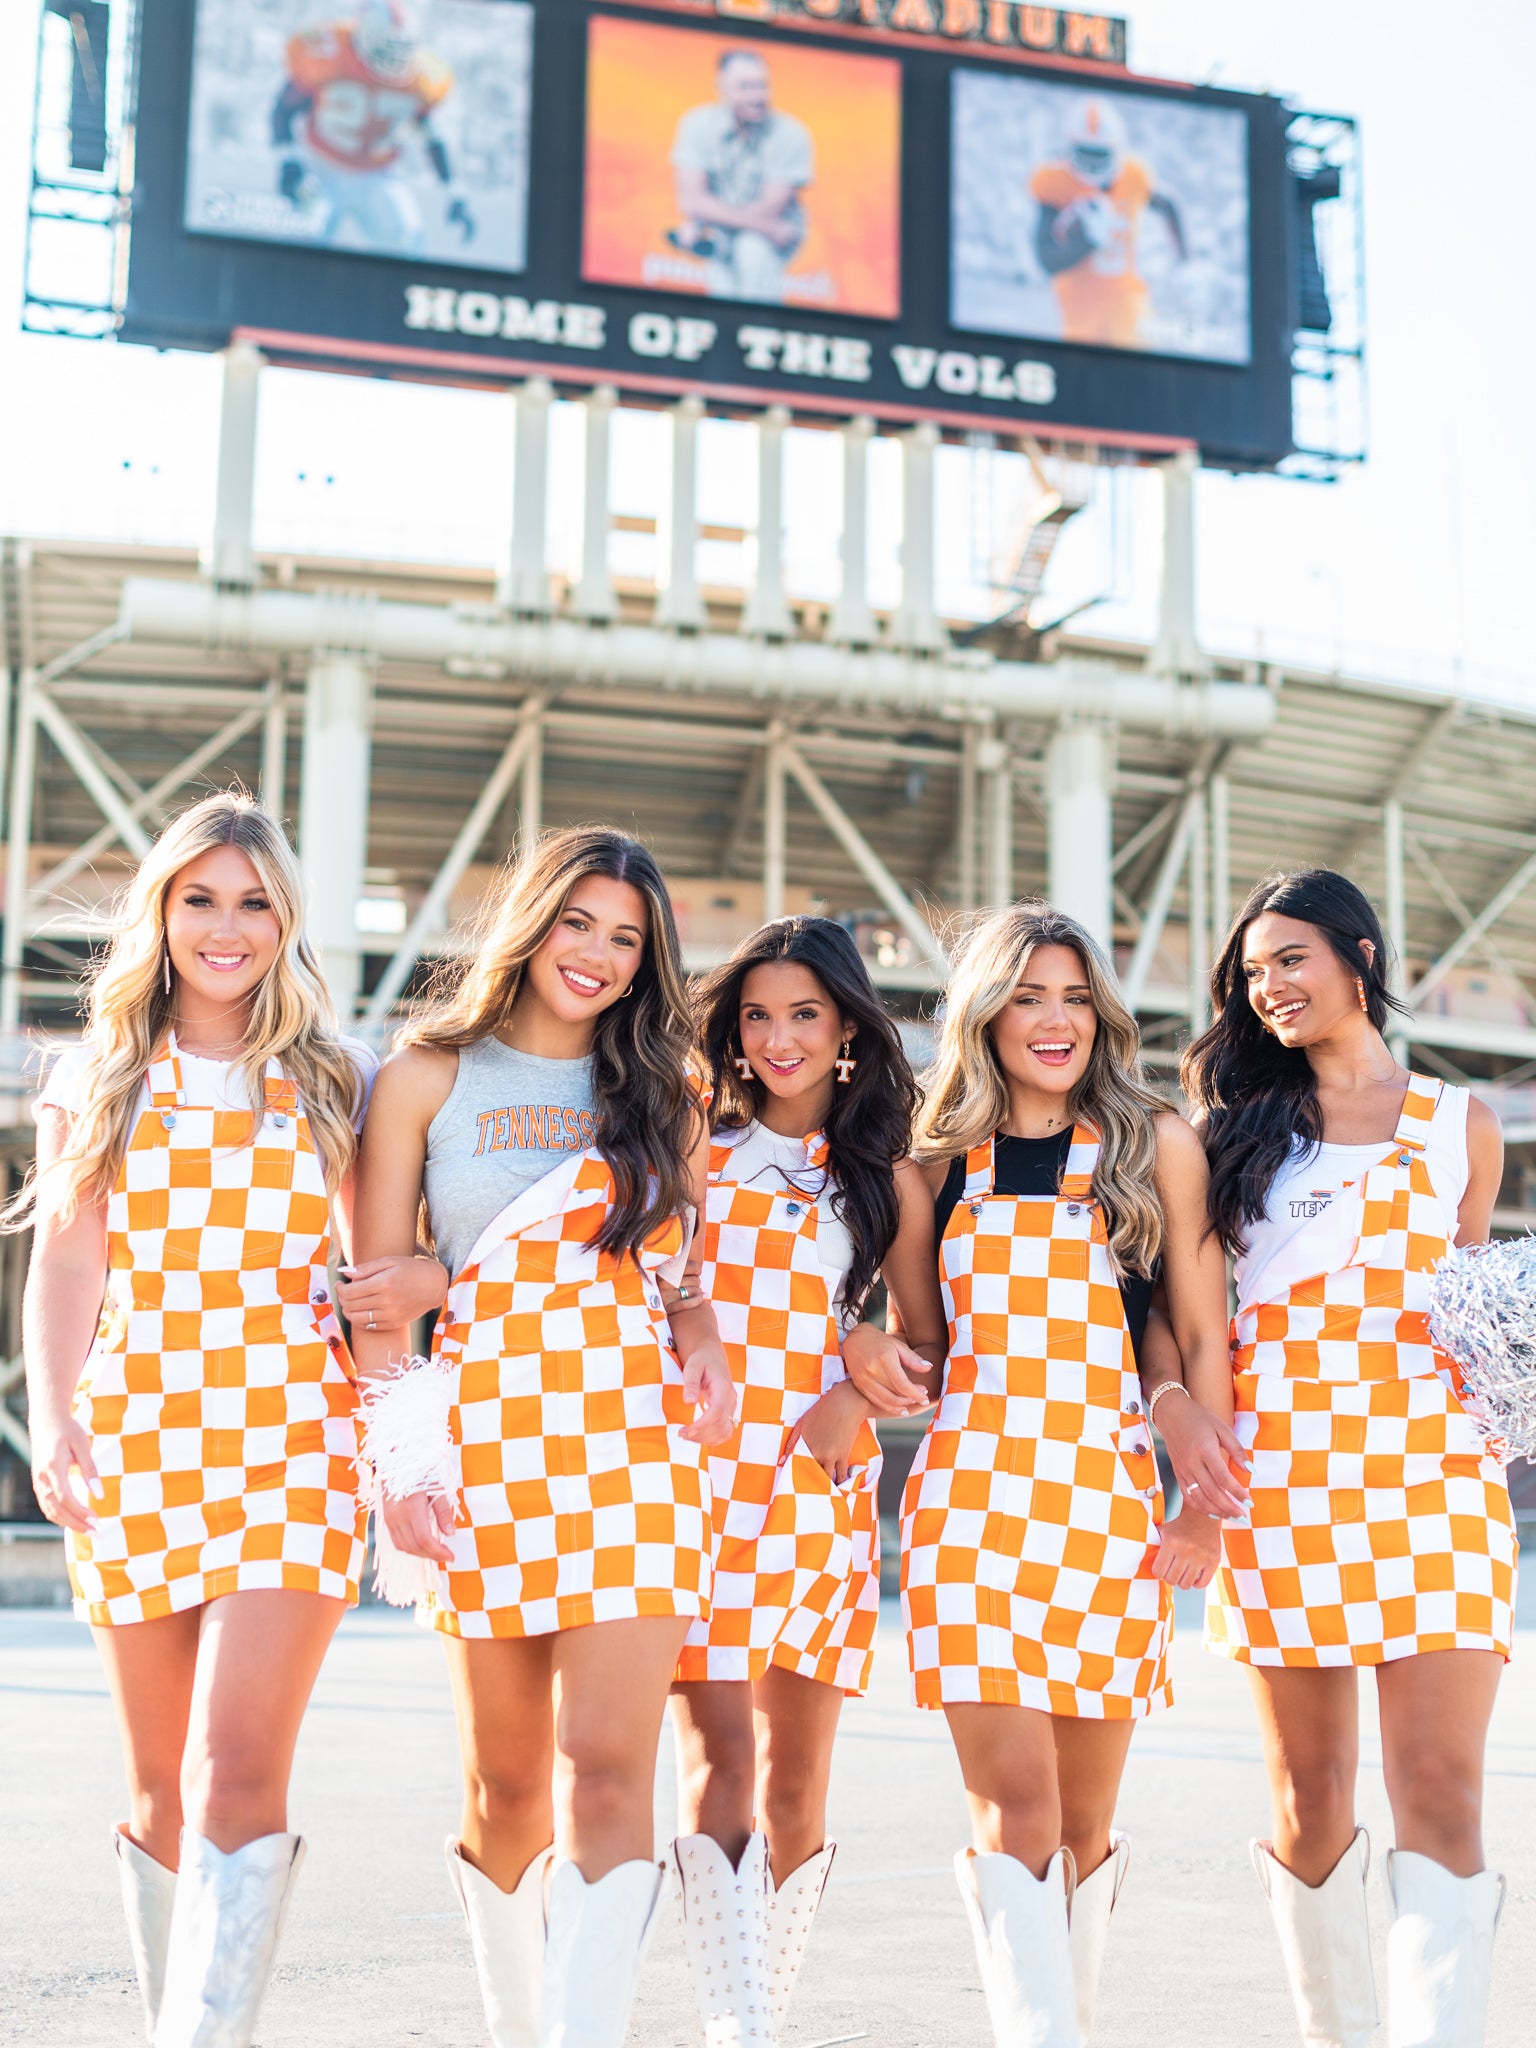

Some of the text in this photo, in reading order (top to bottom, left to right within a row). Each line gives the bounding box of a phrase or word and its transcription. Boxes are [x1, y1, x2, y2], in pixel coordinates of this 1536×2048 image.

[404, 284, 1056, 405] HOME OF THE VOLS
[834, 1058, 857, 1083] T
